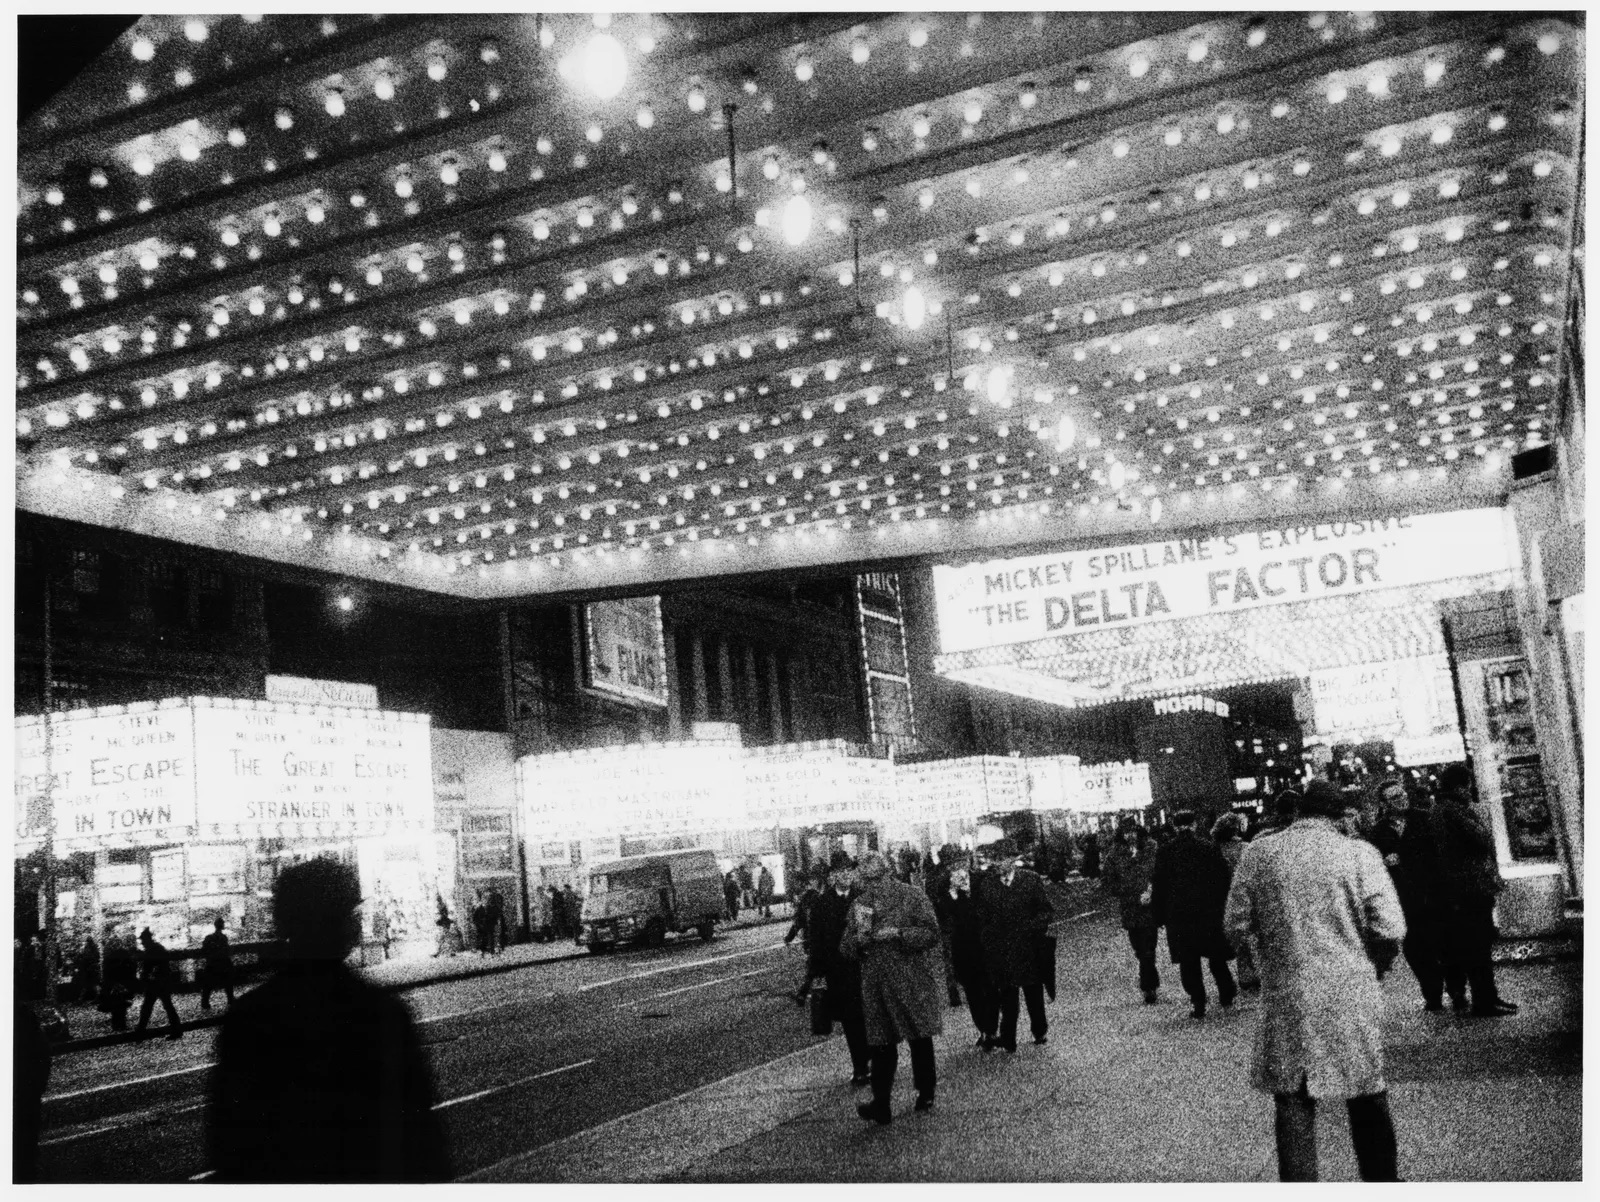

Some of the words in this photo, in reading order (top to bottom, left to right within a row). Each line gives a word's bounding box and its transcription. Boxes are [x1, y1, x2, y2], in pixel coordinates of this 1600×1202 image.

[985, 560, 1073, 595] MICKEY
[1088, 536, 1238, 578] SPILLANE'S
[968, 600, 1029, 627] "THE
[1045, 580, 1171, 632] DELTA
[1207, 541, 1396, 607] FACTOR"
[118, 715, 160, 730] STEVE
[90, 757, 188, 788] ESCAPE
[229, 748, 263, 778] THE
[283, 750, 336, 778] GREAT
[354, 753, 410, 780] ESCAPE
[74, 811, 96, 834] IN
[107, 804, 173, 831] TOWN
[247, 801, 331, 820] STRANGER
[341, 801, 356, 819] IN
[366, 801, 405, 819] TOWN
